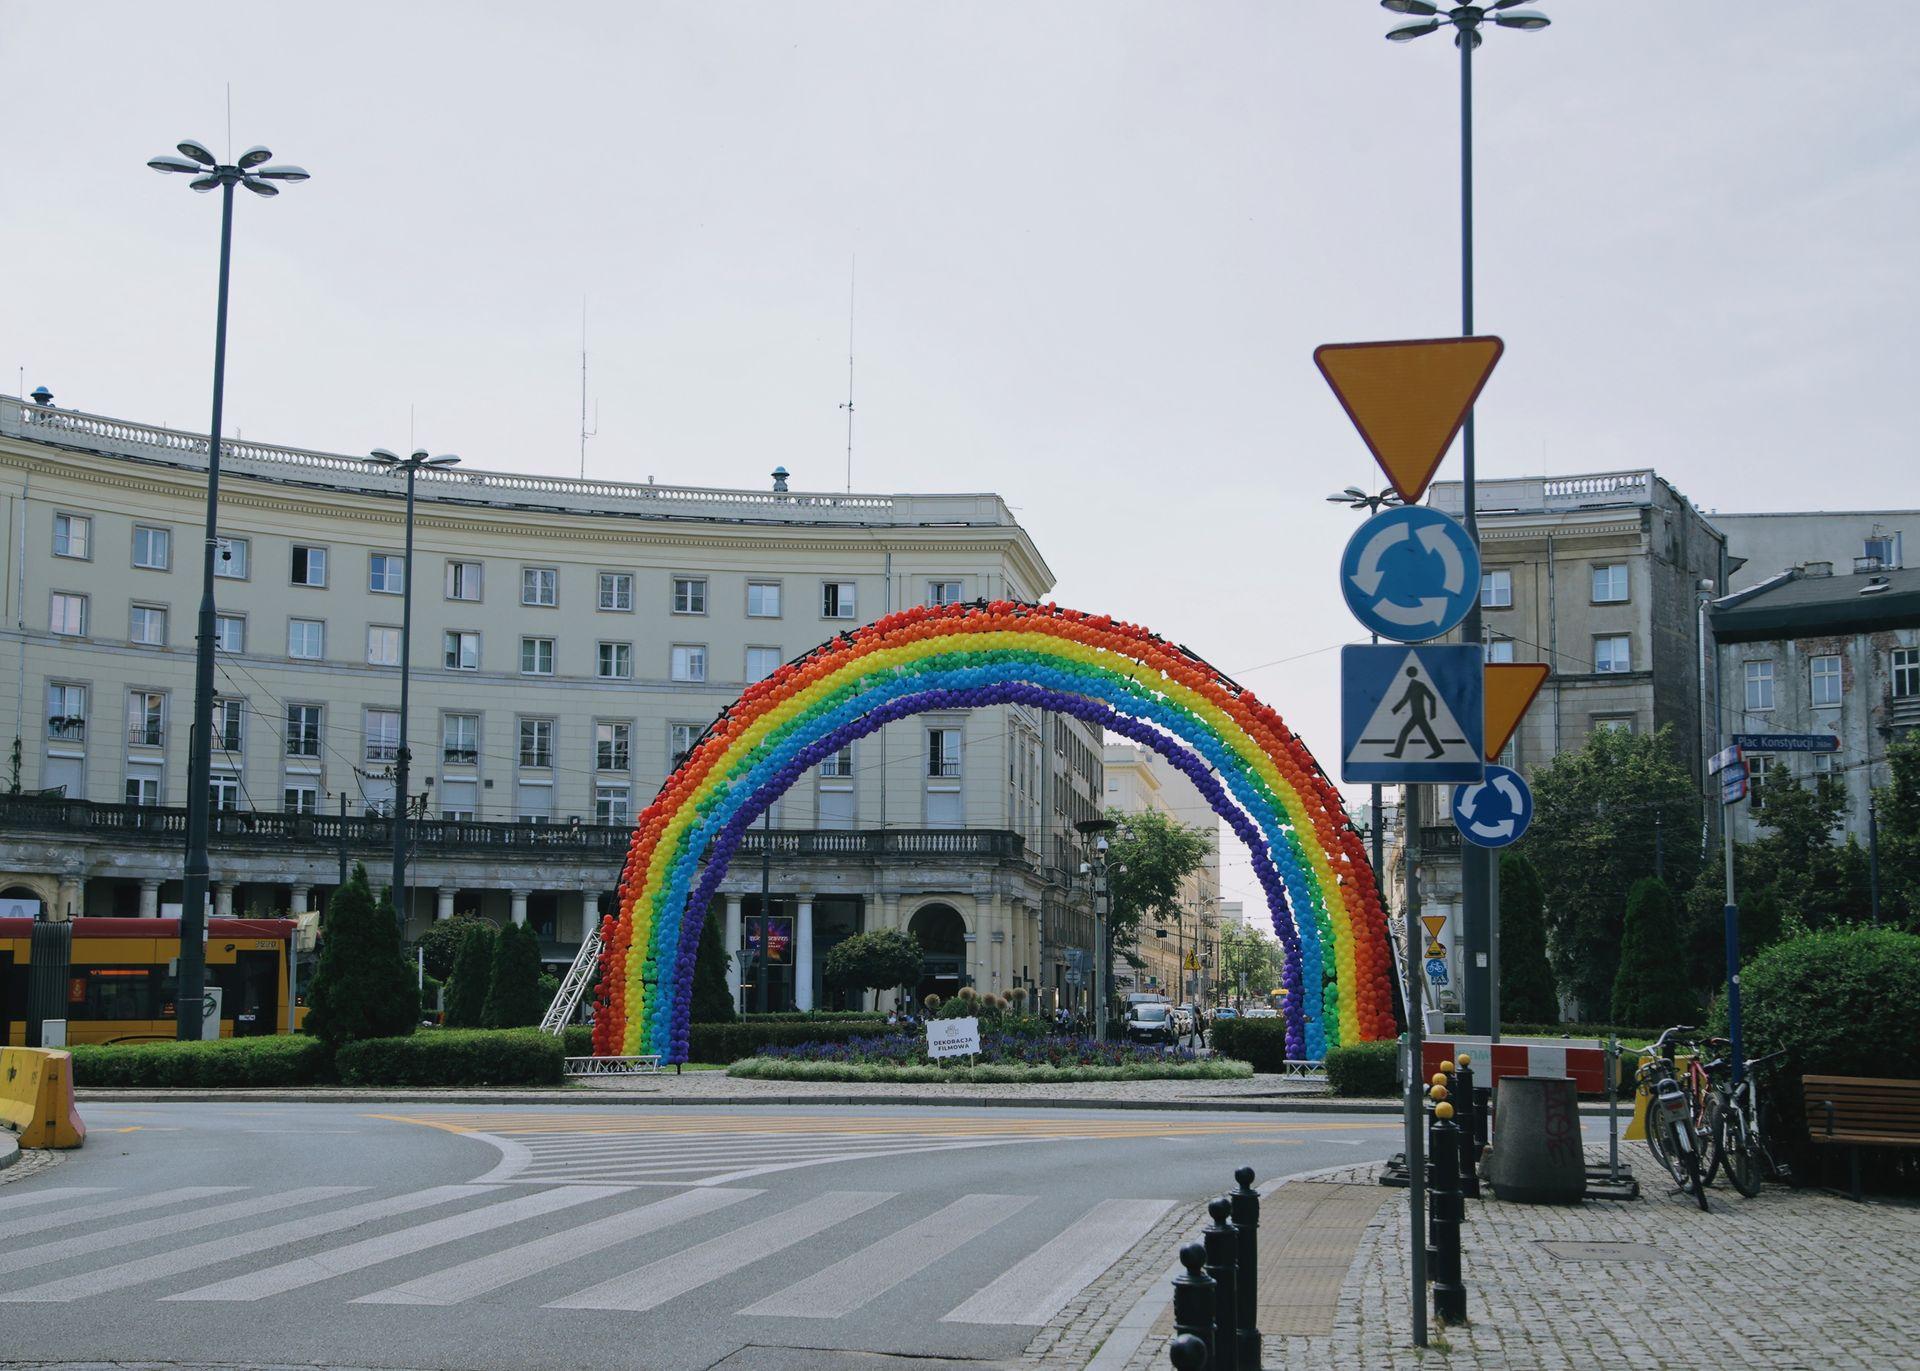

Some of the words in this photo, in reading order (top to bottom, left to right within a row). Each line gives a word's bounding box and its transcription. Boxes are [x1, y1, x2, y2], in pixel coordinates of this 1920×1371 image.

[1737, 736, 1758, 748] Plac
[1761, 736, 1814, 750] Konstytucji
[933, 1037, 973, 1046] DEKORACJA
[937, 1043, 970, 1051] FILMOWA
